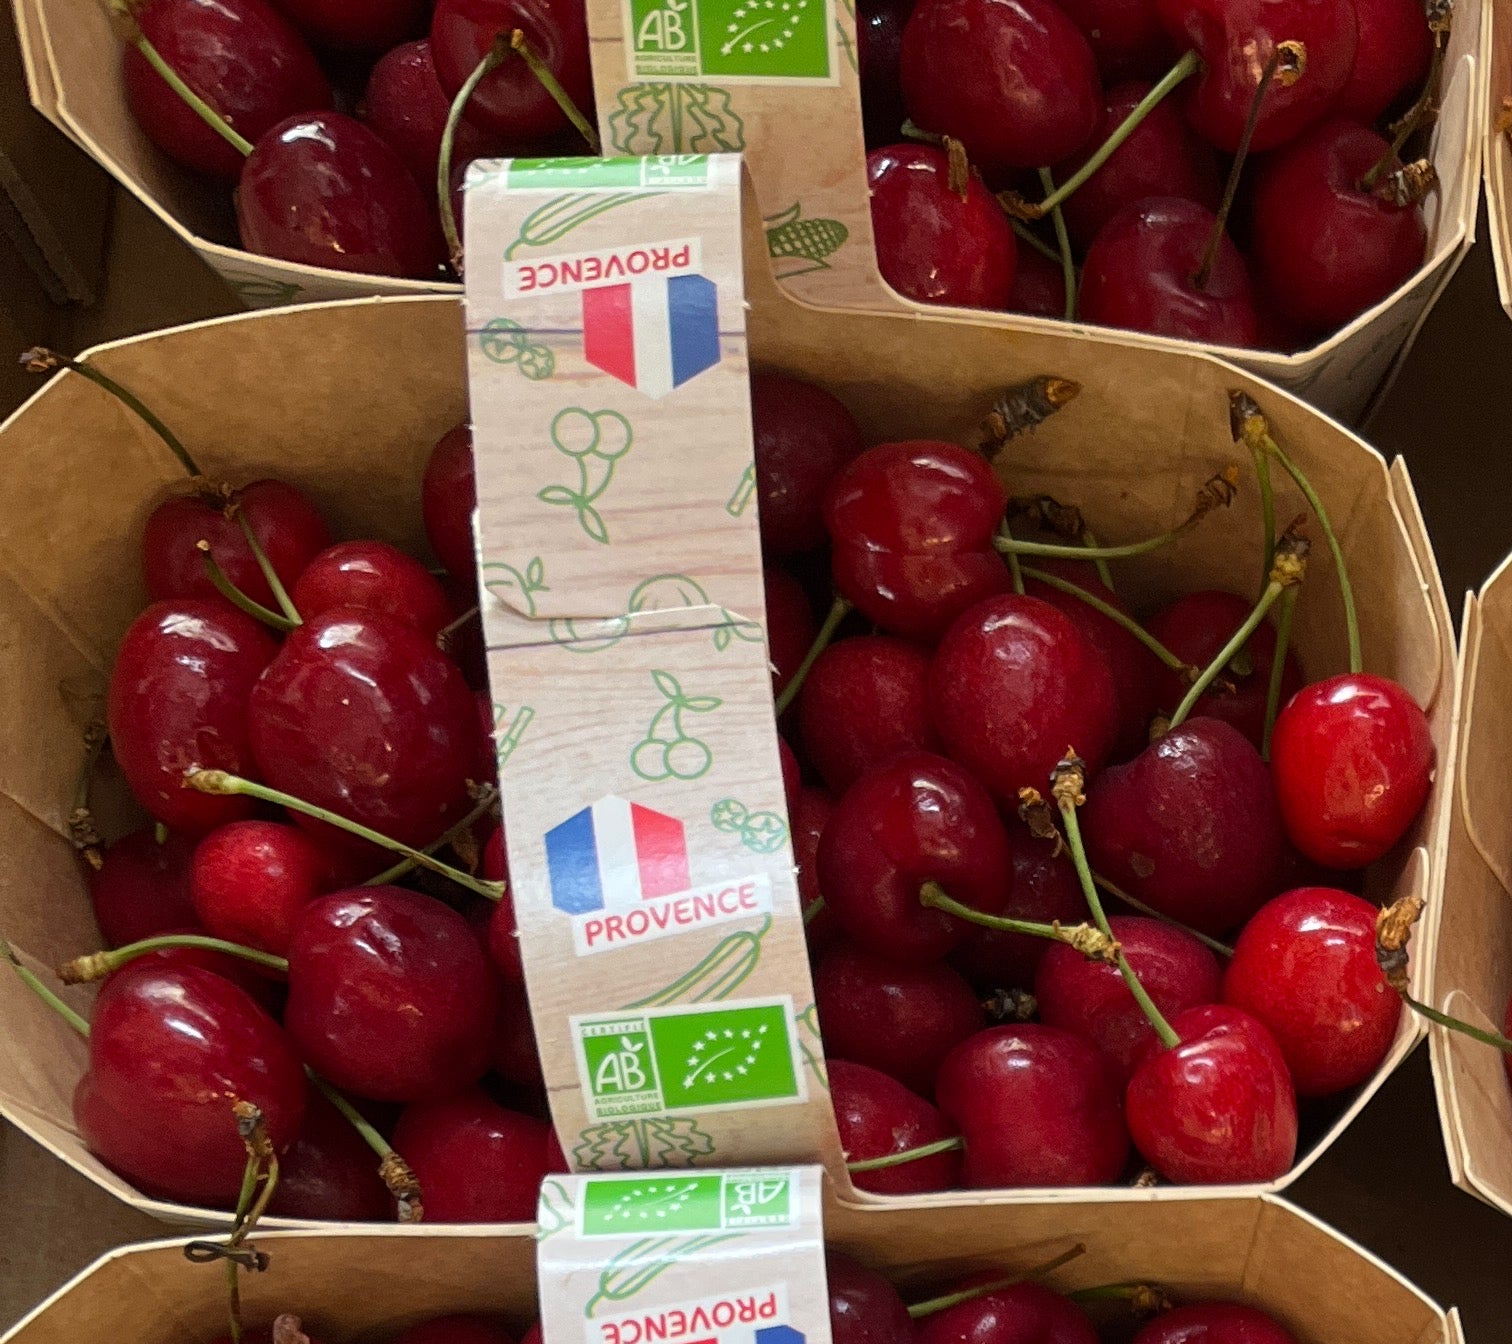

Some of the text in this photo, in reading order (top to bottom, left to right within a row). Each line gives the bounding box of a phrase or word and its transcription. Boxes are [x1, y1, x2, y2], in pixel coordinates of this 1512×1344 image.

[637, 9, 686, 50] AB
[518, 244, 690, 291] PROVENCE
[583, 882, 757, 947] PROVENCE
[595, 1052, 646, 1093] AB
[594, 1092, 659, 1105] AGRICULTURE
[596, 1102, 662, 1115] BIOLOGIQUE
[734, 1181, 785, 1205] AB
